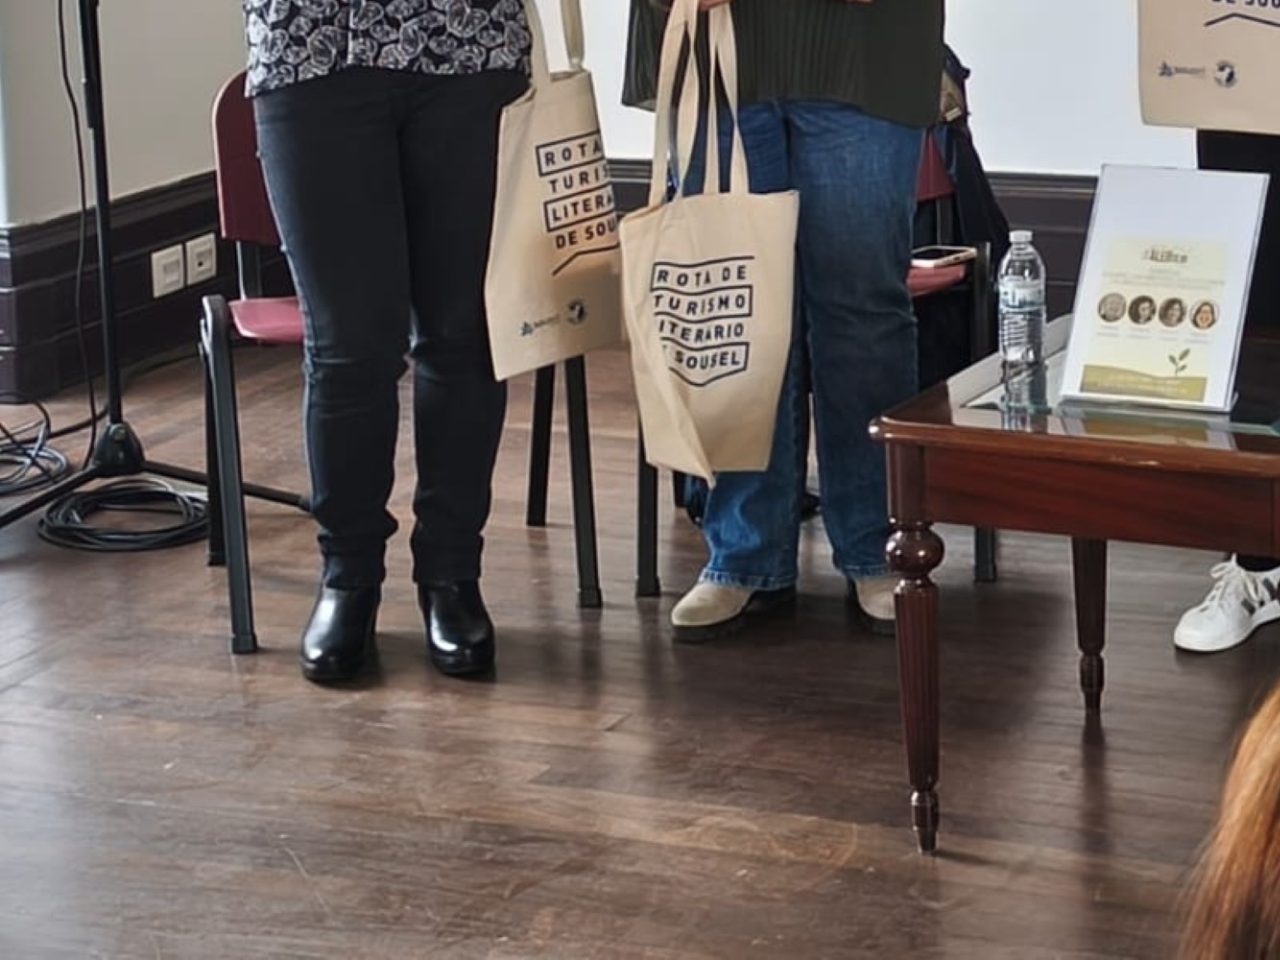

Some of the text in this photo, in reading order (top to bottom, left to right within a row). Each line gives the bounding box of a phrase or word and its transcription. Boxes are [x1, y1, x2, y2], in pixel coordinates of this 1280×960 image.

[555, 230, 578, 249] DE
[656, 265, 746, 287] ROTA DE
[654, 294, 745, 316] TURISMO
[674, 350, 741, 370] SOUSEL
